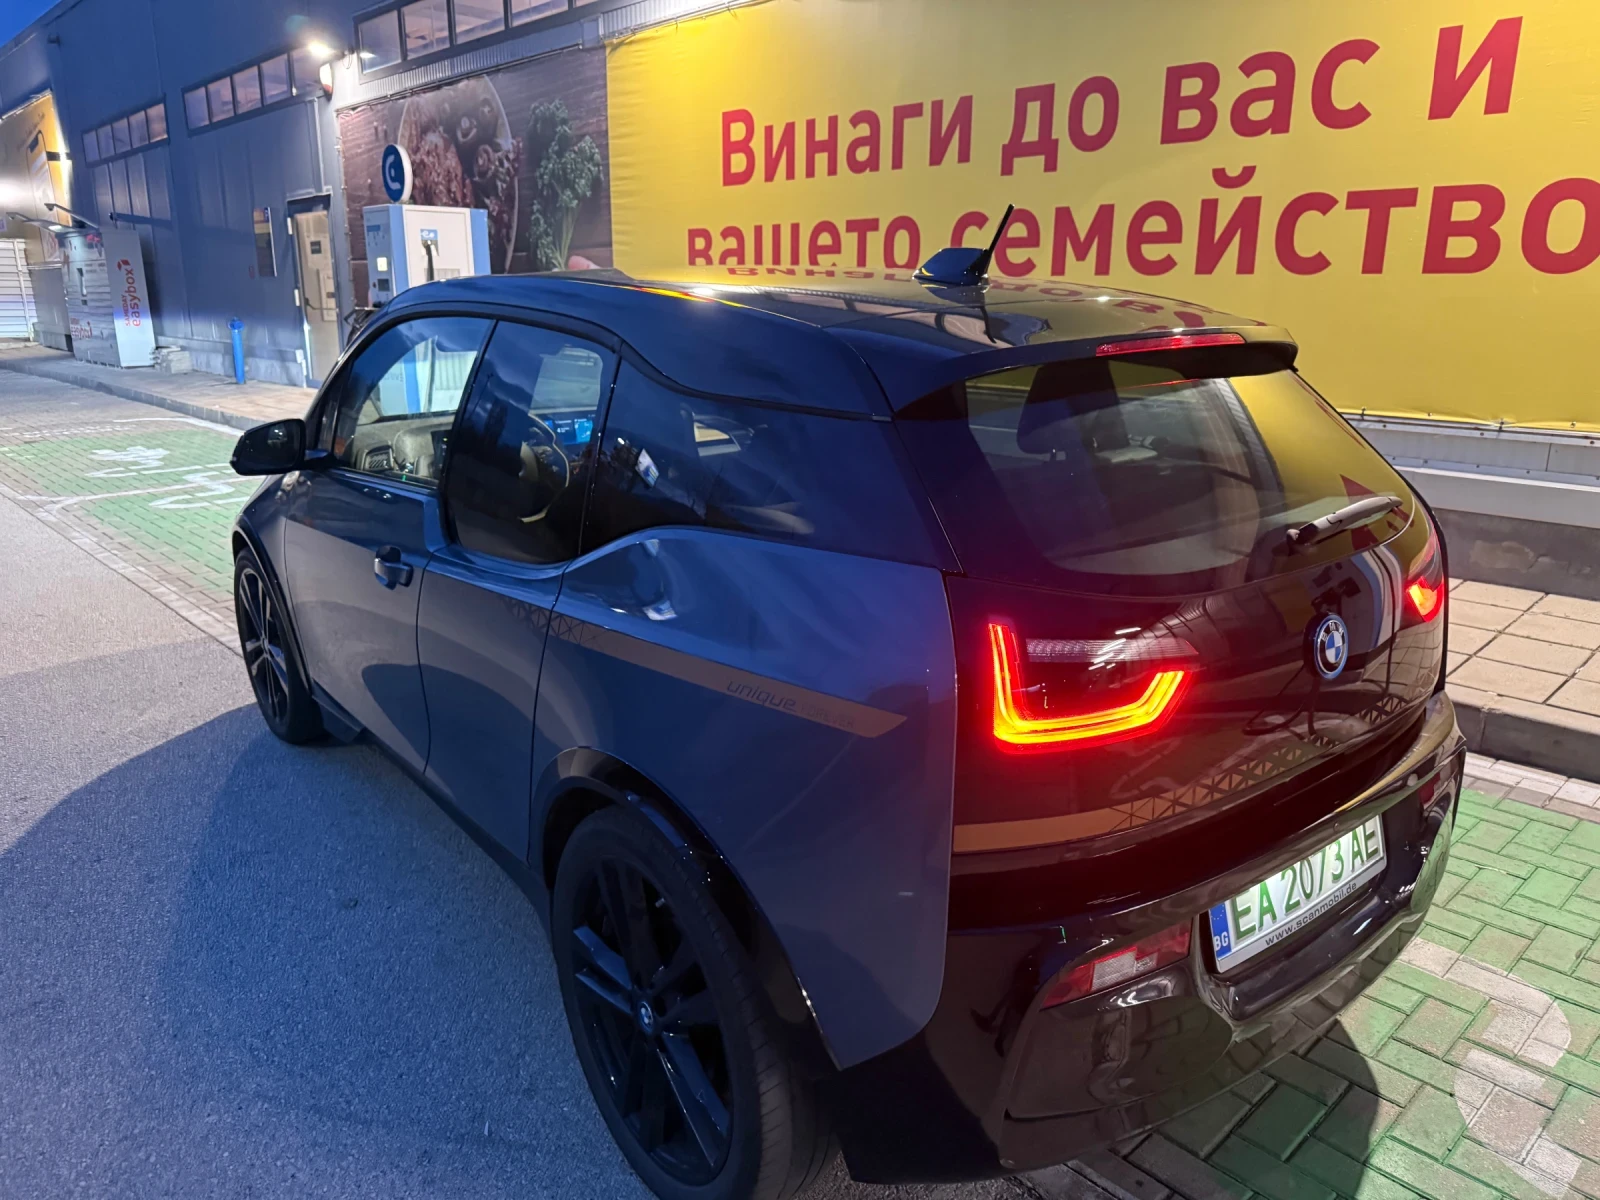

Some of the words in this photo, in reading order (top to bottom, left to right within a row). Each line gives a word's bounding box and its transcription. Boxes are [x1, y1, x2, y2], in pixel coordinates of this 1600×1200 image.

[722, 95, 973, 186] Винаги
[1000, 78, 1120, 176] до
[1160, 38, 1381, 145] вас
[1428, 16, 1523, 120] и
[688, 215, 921, 269] вашето
[950, 165, 1600, 279] семейство
[125, 268, 141, 327] easybox
[1320, 621, 1345, 642] BMW
[726, 680, 798, 714] unique
[1233, 880, 1278, 941] EA
[1280, 838, 1345, 916] 2073
[1351, 824, 1379, 873] AE
[1213, 931, 1229, 951] BG
[1265, 882, 1357, 946] www.scanmobil.de
